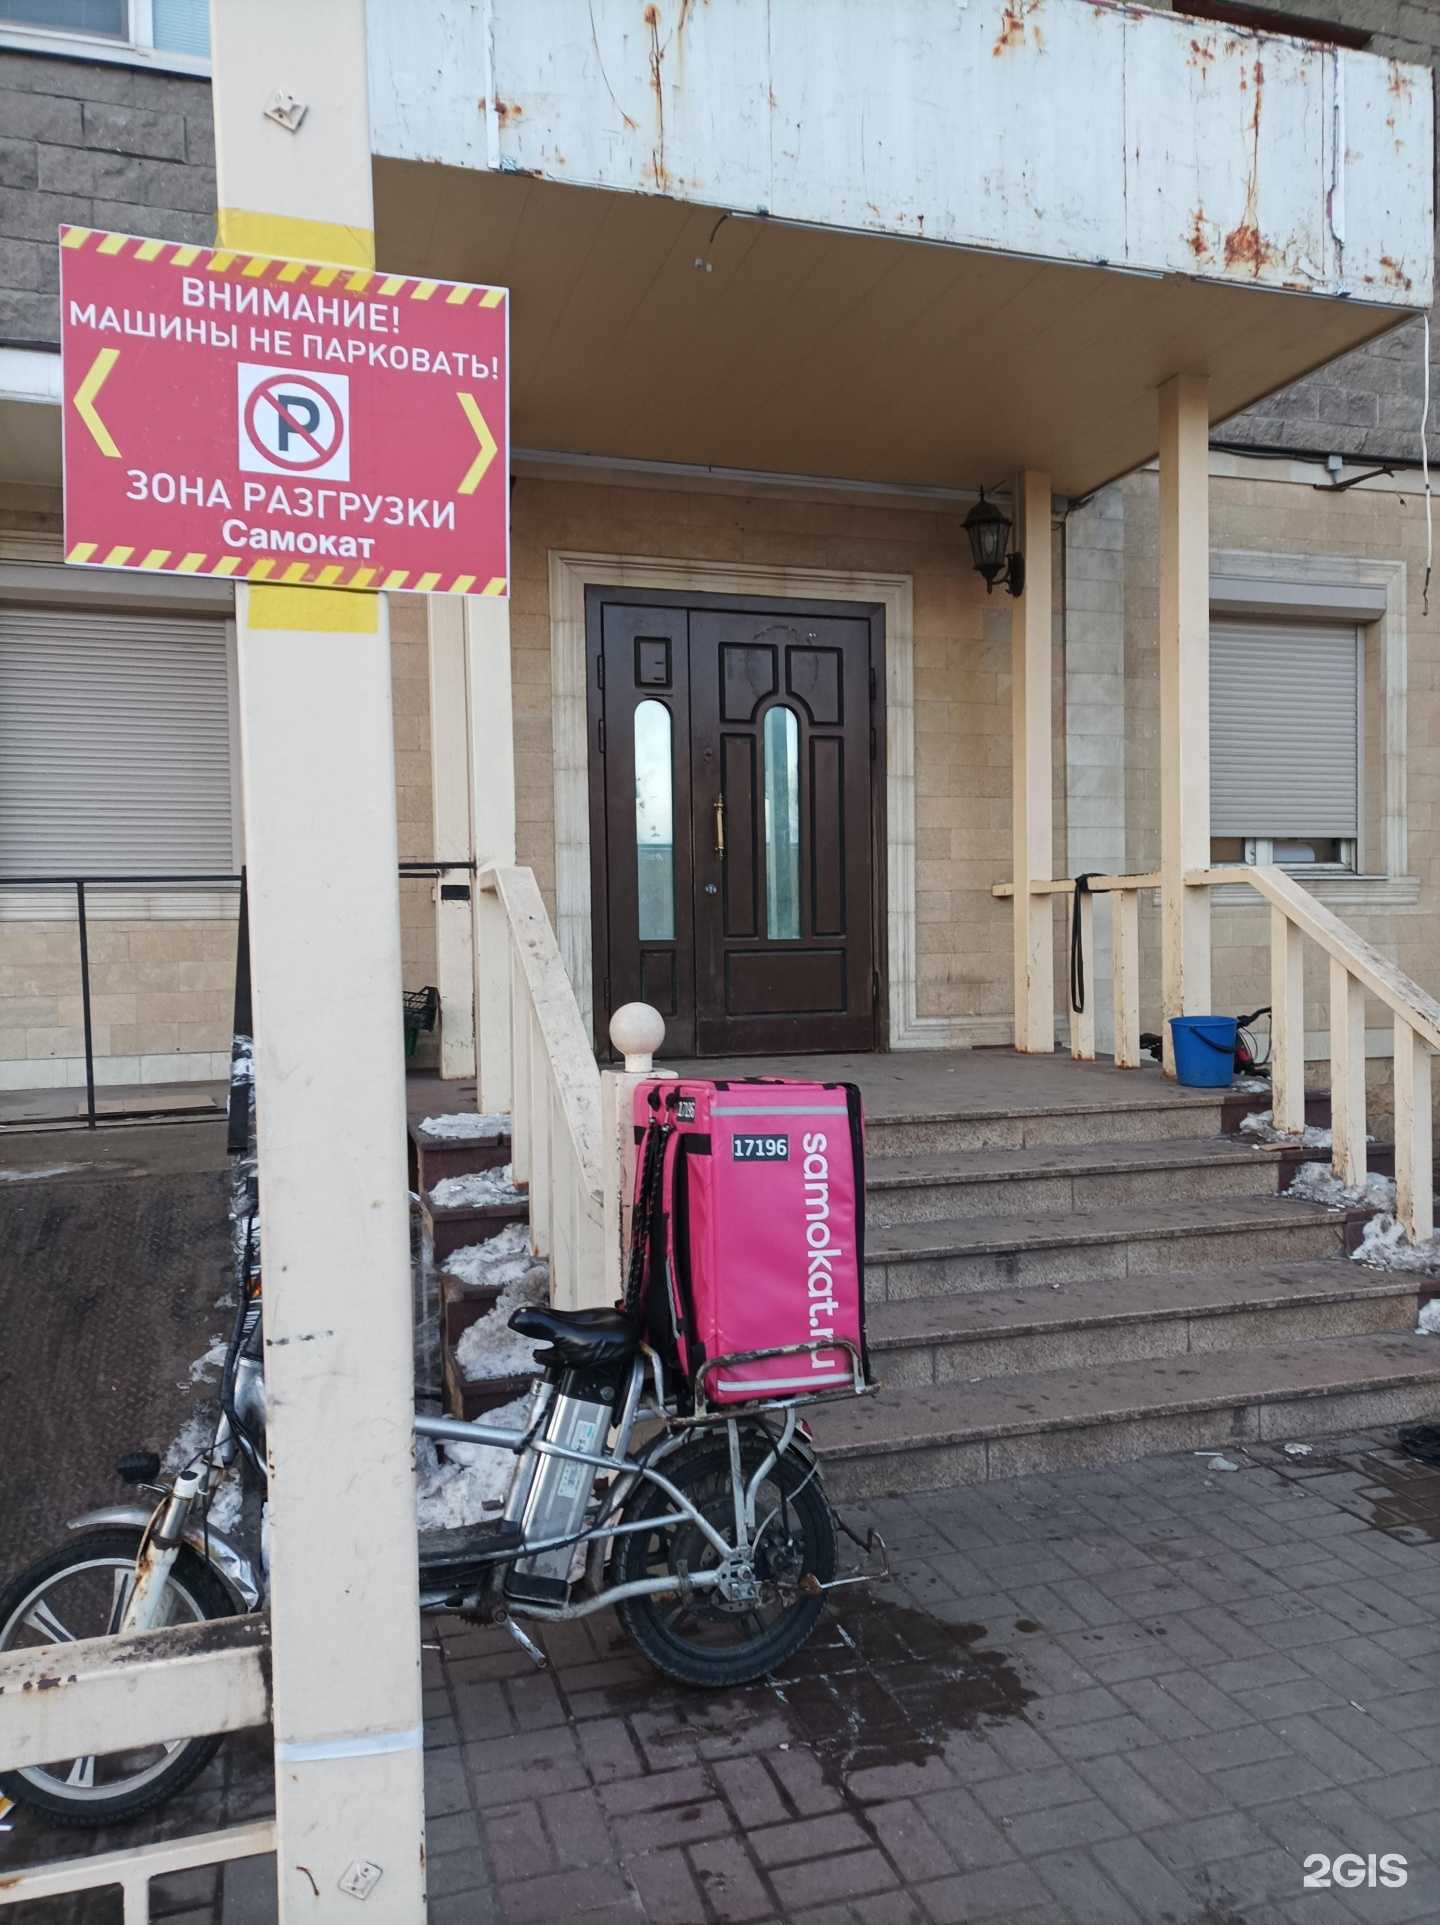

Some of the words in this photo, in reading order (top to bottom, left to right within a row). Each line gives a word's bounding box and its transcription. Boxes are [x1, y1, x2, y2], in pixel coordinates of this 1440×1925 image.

[181, 276, 400, 334] ВНИМАНИЕ!
[69, 301, 238, 350] МАШИНЫ
[249, 326, 293, 357] НЕ
[302, 332, 500, 380] ПАРКОВАТЬ!
[125, 469, 232, 510] ЗОНА
[243, 482, 457, 530] РАЗГРУЗКИ
[221, 518, 375, 559] Самокат
[734, 1139, 787, 1157] 17196
